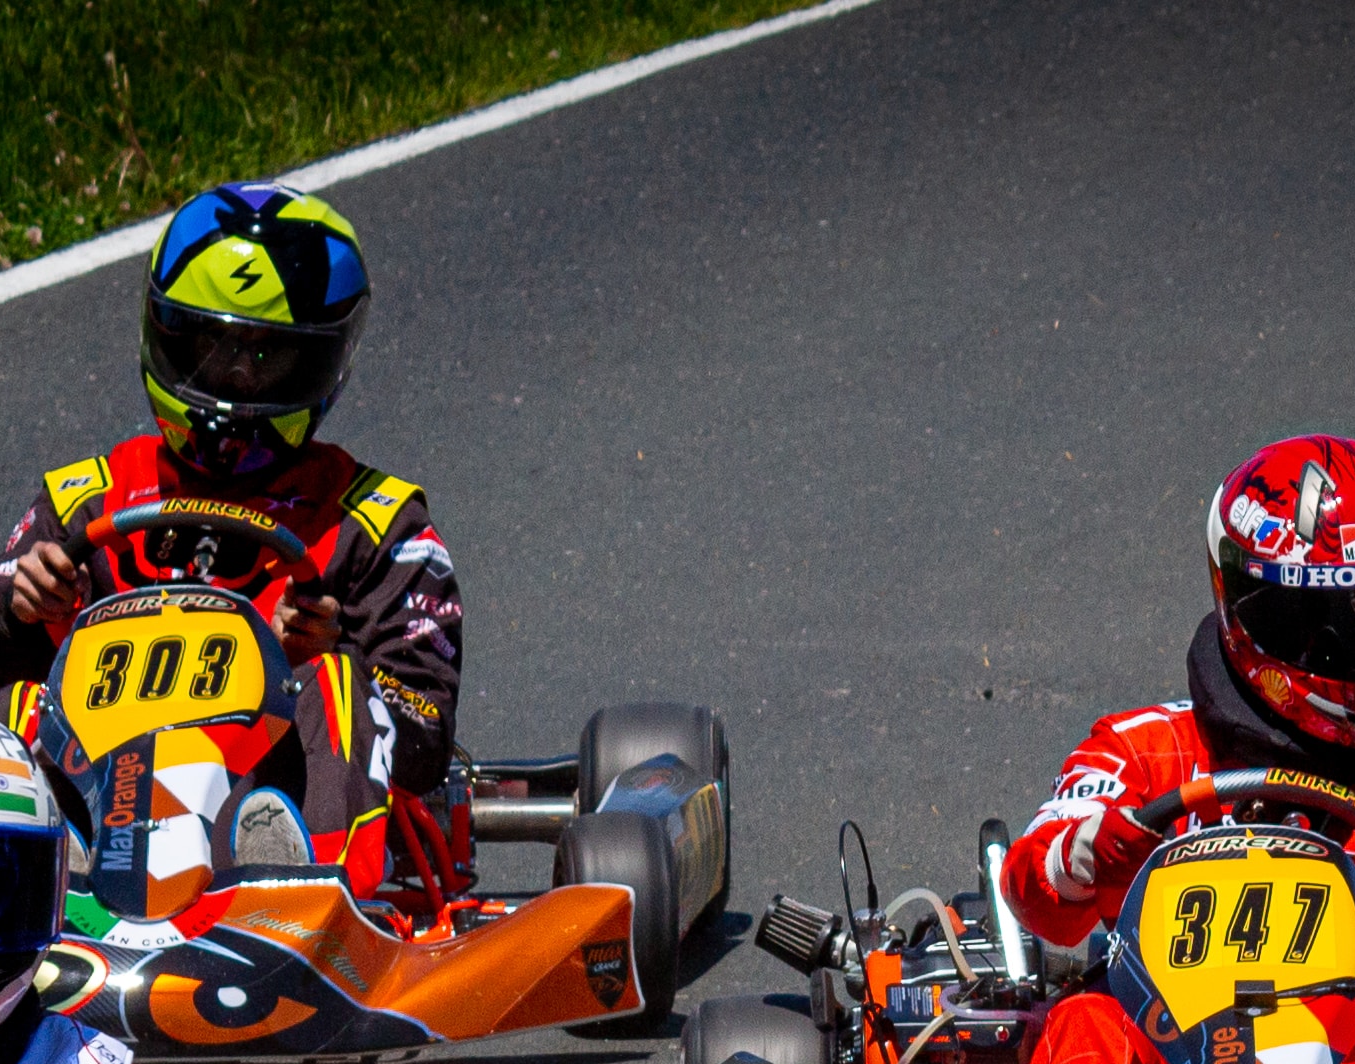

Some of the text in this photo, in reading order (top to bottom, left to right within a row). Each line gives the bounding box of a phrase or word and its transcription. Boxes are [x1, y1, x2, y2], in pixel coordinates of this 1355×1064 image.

[161, 497, 278, 531] INTREPID
[1229, 494, 1268, 539] elf
[86, 592, 238, 627] INTREPID
[86, 633, 238, 711] 303
[1164, 835, 1330, 867] INTREPID
[1168, 881, 1332, 969] 347
